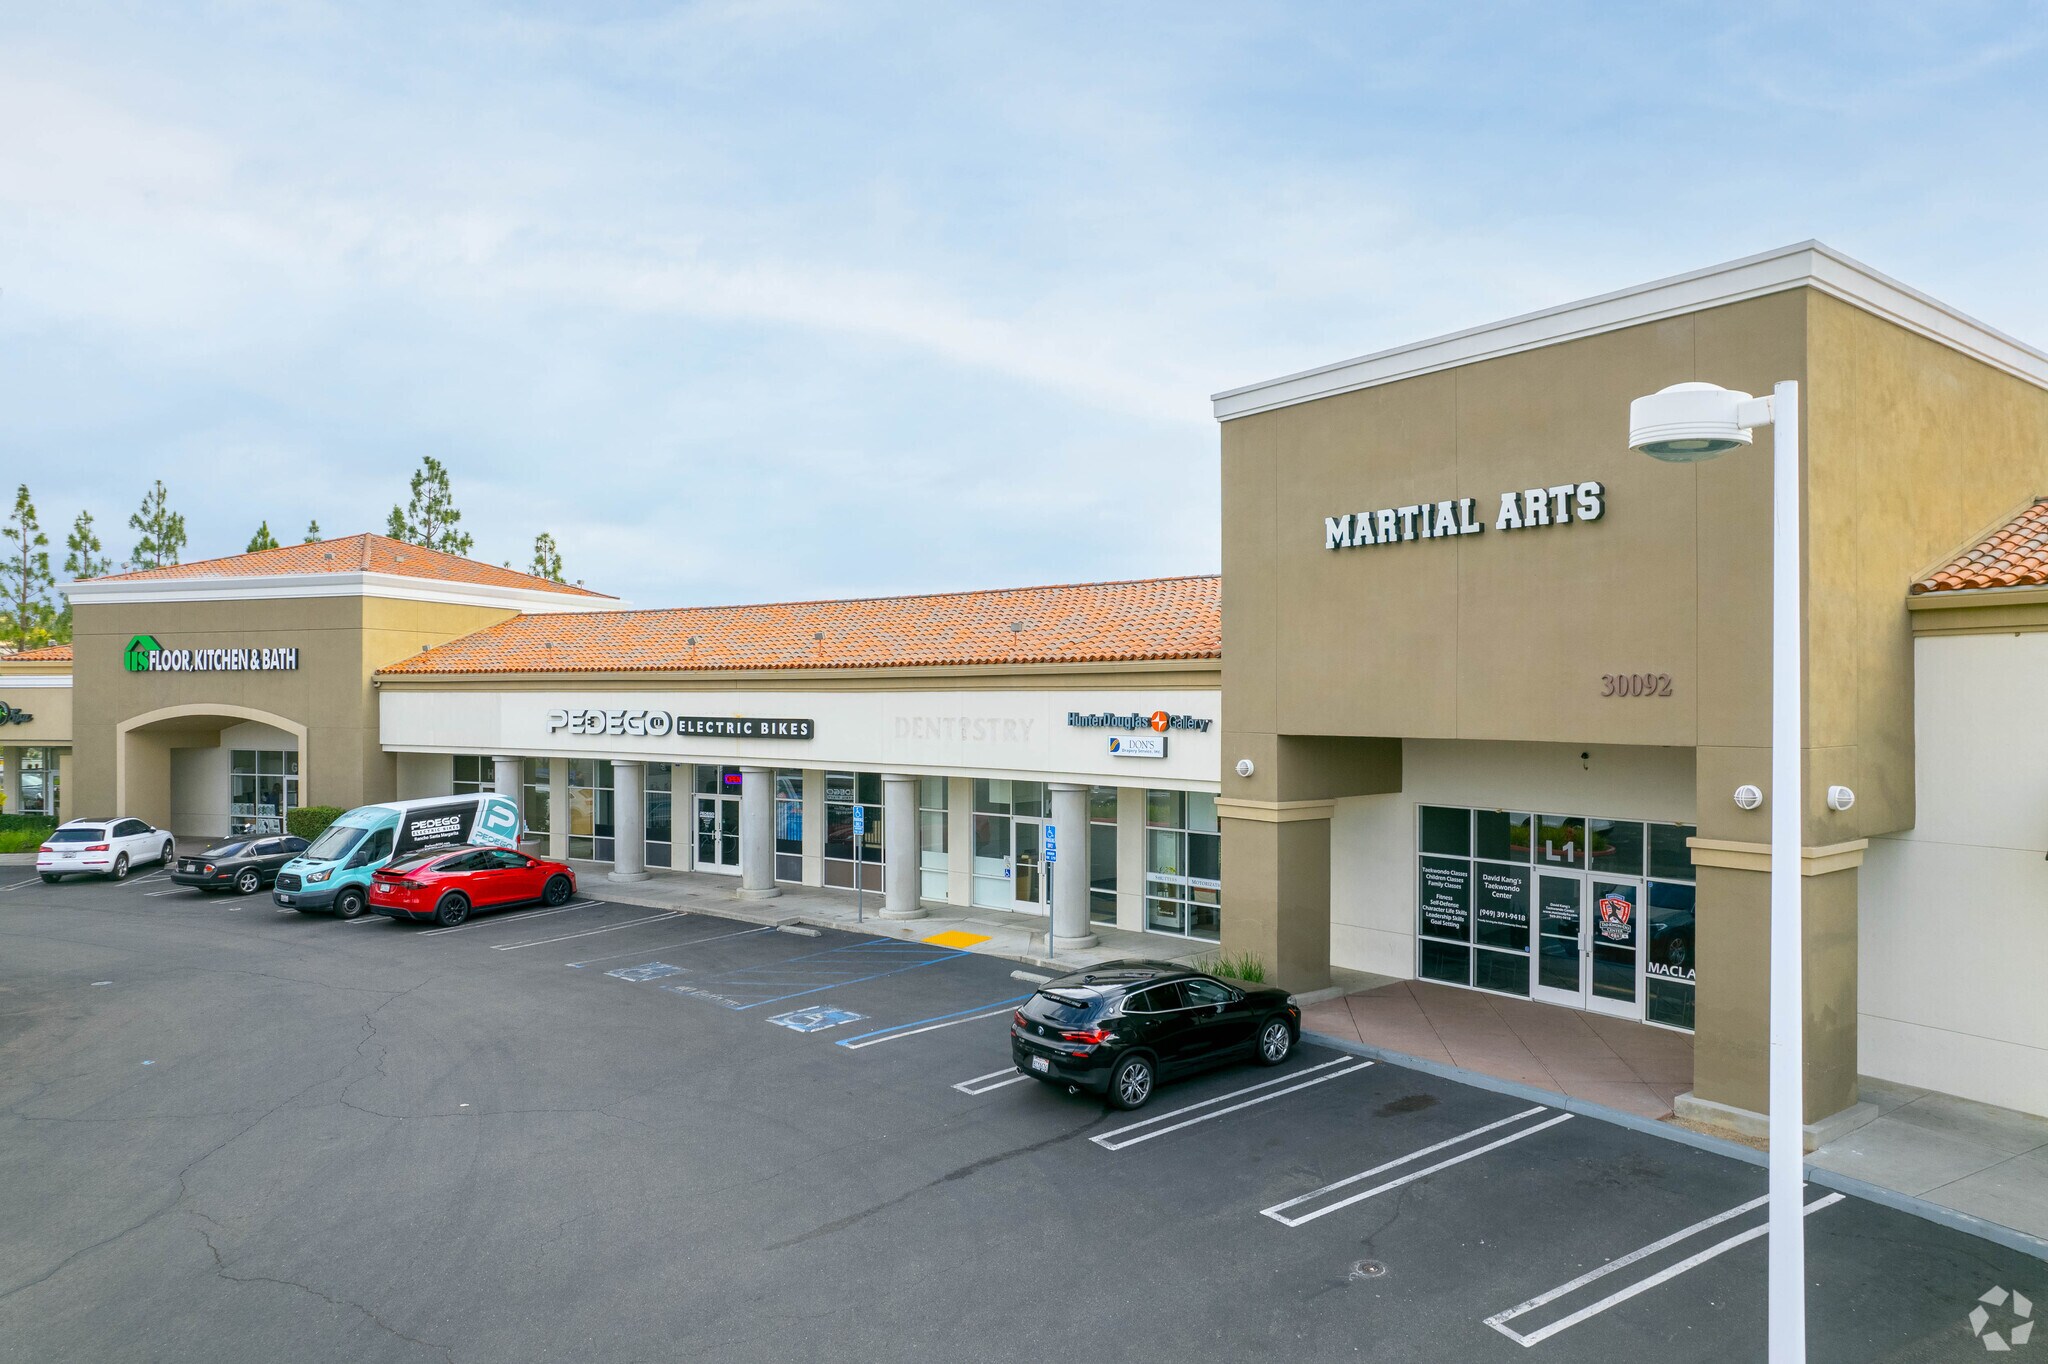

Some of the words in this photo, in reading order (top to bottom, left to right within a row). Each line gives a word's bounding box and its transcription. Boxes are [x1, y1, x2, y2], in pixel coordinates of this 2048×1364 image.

[1325, 497, 1482, 550] MARTIAL
[1496, 481, 1603, 530] ARTS
[195, 648, 249, 671] KITCHEN
[250, 648, 261, 670] &
[262, 647, 297, 670] BATH
[1601, 672, 1673, 697] 30092
[546, 709, 673, 737] PEDEGO
[678, 720, 752, 735] ELECTRIC
[760, 721, 809, 736] BIKES
[1168, 714, 1207, 732] Gallery
[1129, 739, 1155, 750] DON'S
[486, 805, 516, 828] P
[410, 816, 461, 831] PEDEGO
[1546, 840, 1574, 862] L1
[1422, 866, 1450, 874] Taekwondo
[1428, 880, 1444, 888] Family
[1482, 874, 1500, 882] David
[1501, 876, 1522, 886] Kang's
[1484, 882, 1520, 892] Taekwondo
[1492, 891, 1512, 900] Center
[1422, 904, 1446, 912] Character
[1430, 900, 1459, 908] Self-Defense
[1426, 912, 1452, 920] Leadership
[1480, 909, 1496, 918] (949)
[1496, 912, 1526, 922] 391-9418
[1442, 920, 1460, 930] Setting
